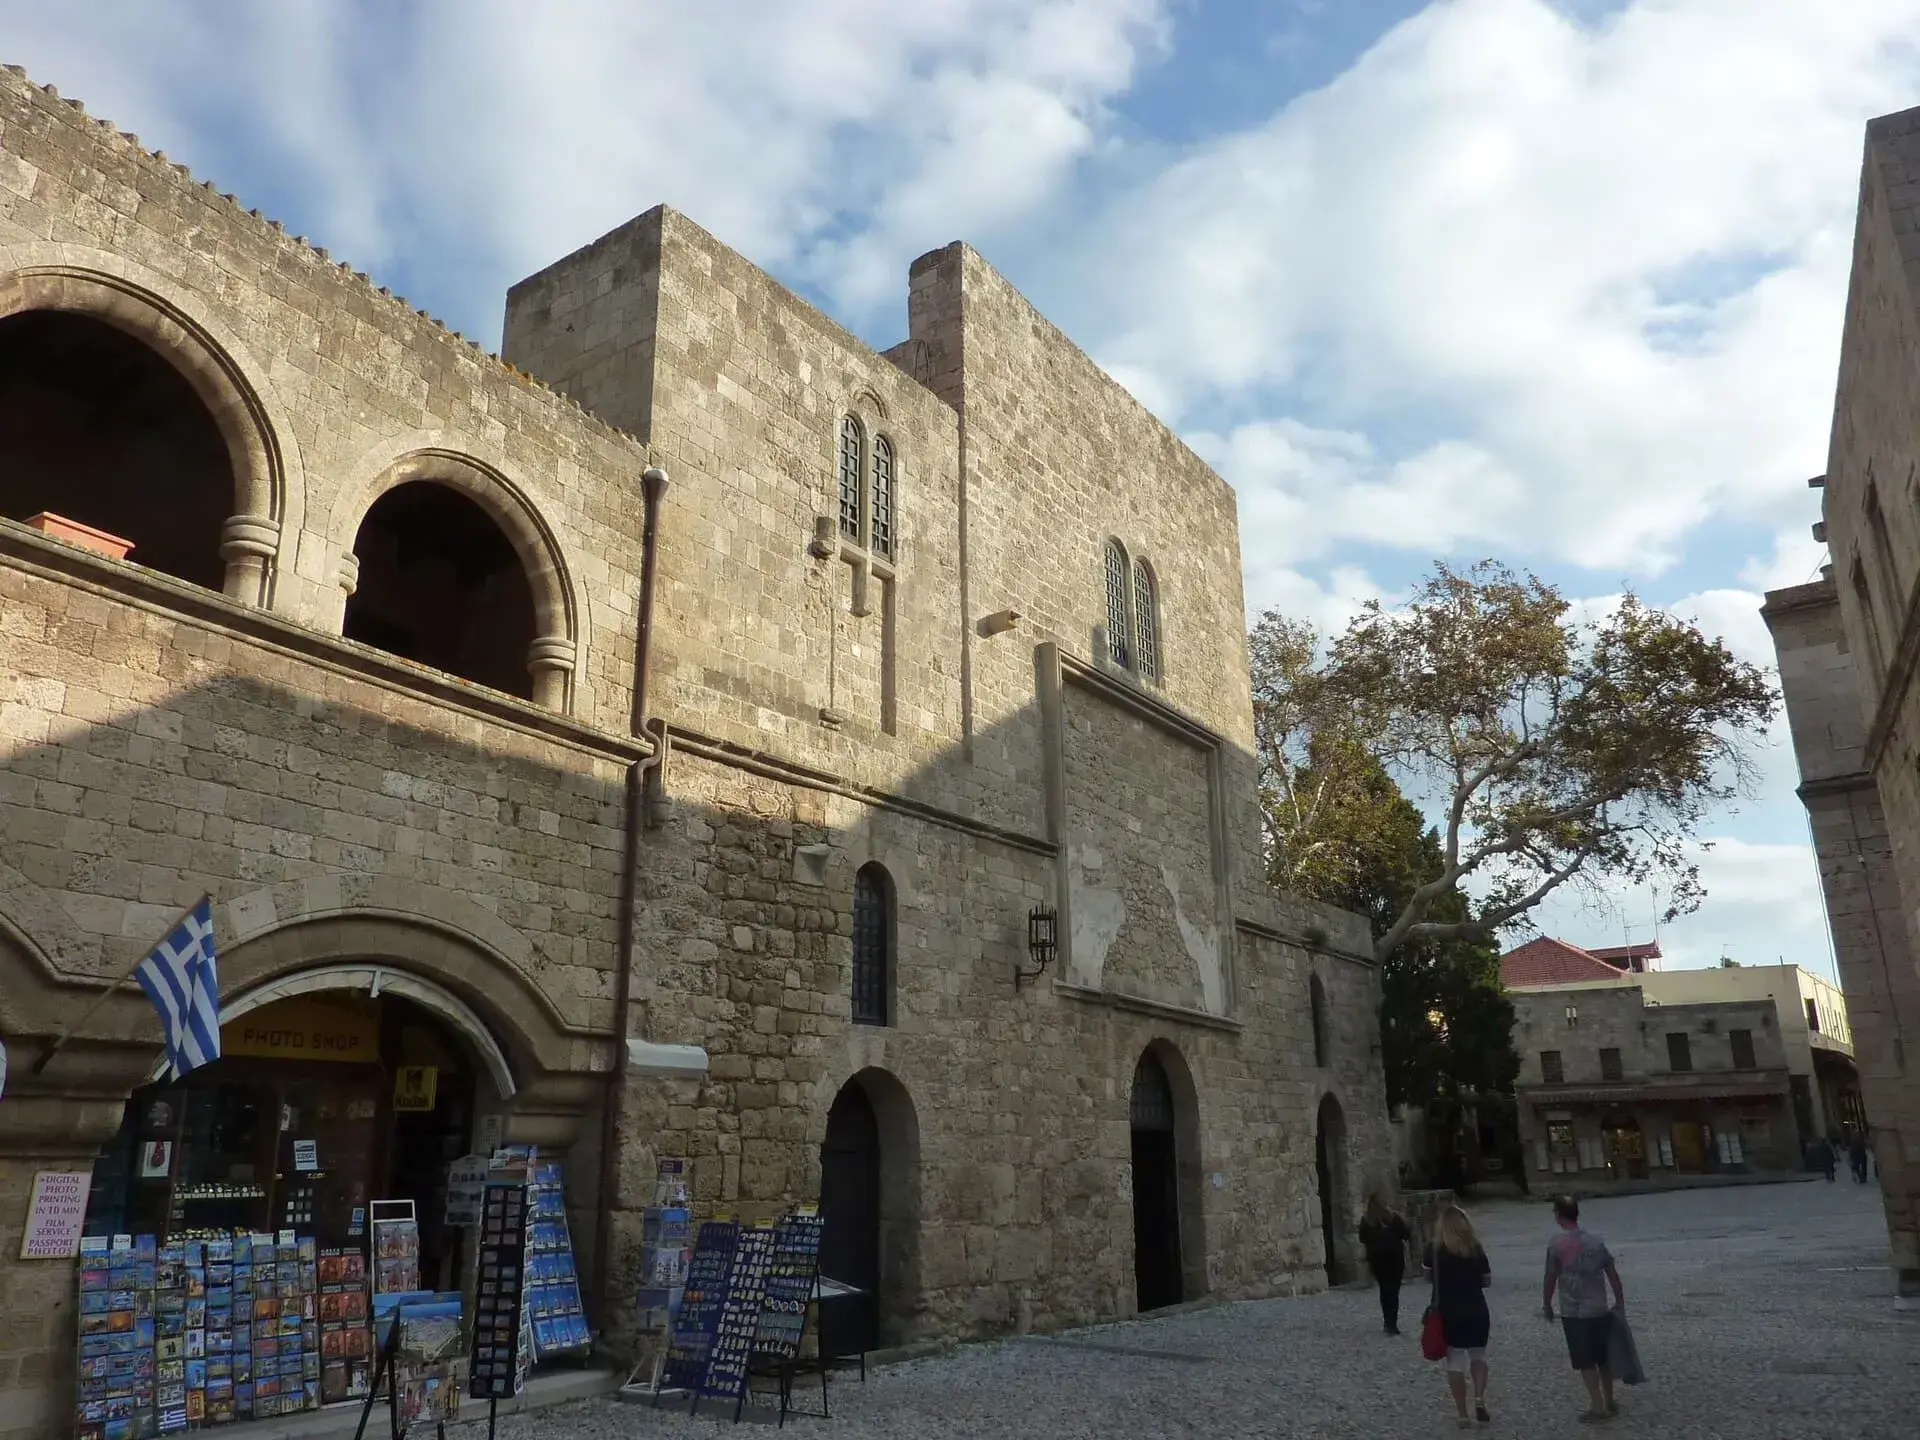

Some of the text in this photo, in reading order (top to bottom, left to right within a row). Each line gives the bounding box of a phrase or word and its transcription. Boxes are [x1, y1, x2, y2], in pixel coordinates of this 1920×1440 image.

[243, 1027, 360, 1051] PHOTO SHOP
[46, 1175, 81, 1184] DIGITAL
[45, 1185, 78, 1194] PHOTO
[39, 1195, 81, 1203] PRINTING
[35, 1206, 46, 1214] IN
[61, 1206, 80, 1214] MIN
[45, 1219, 65, 1227] FILM
[36, 1228, 71, 1236] SERVICE
[28, 1239, 73, 1247] PASSPORT
[27, 1247, 73, 1255] PHOTOS
